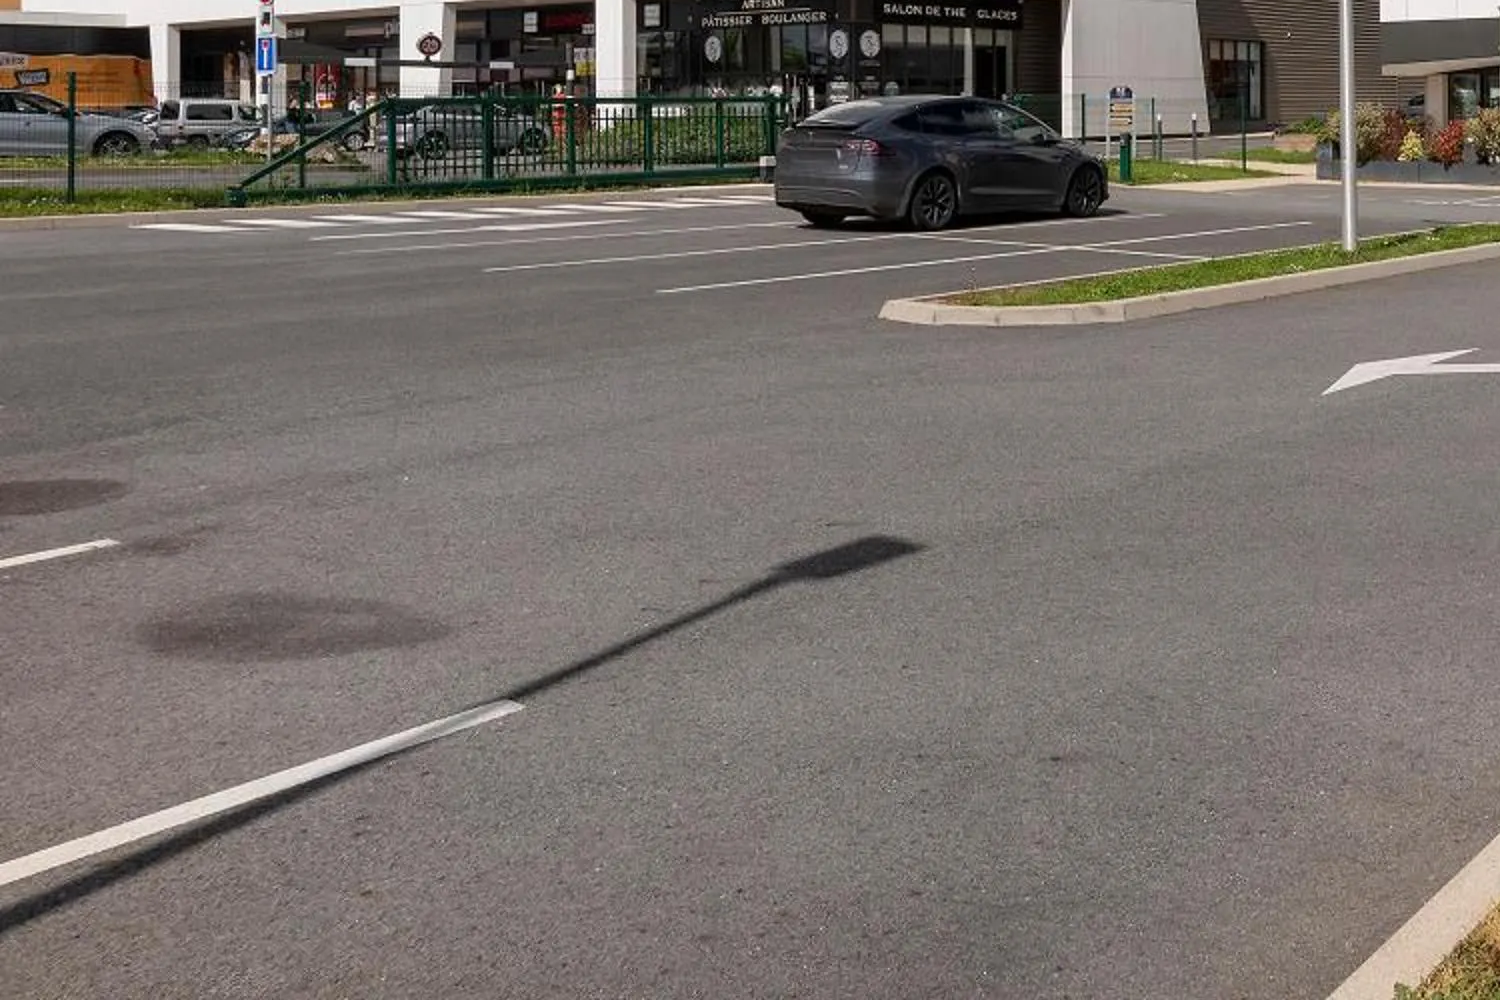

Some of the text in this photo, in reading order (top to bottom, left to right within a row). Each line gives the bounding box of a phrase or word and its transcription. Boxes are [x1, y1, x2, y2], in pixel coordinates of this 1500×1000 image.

[883, 3, 923, 15] SALON
[925, 5, 940, 16] DE
[761, 11, 827, 25] BOULANGER
